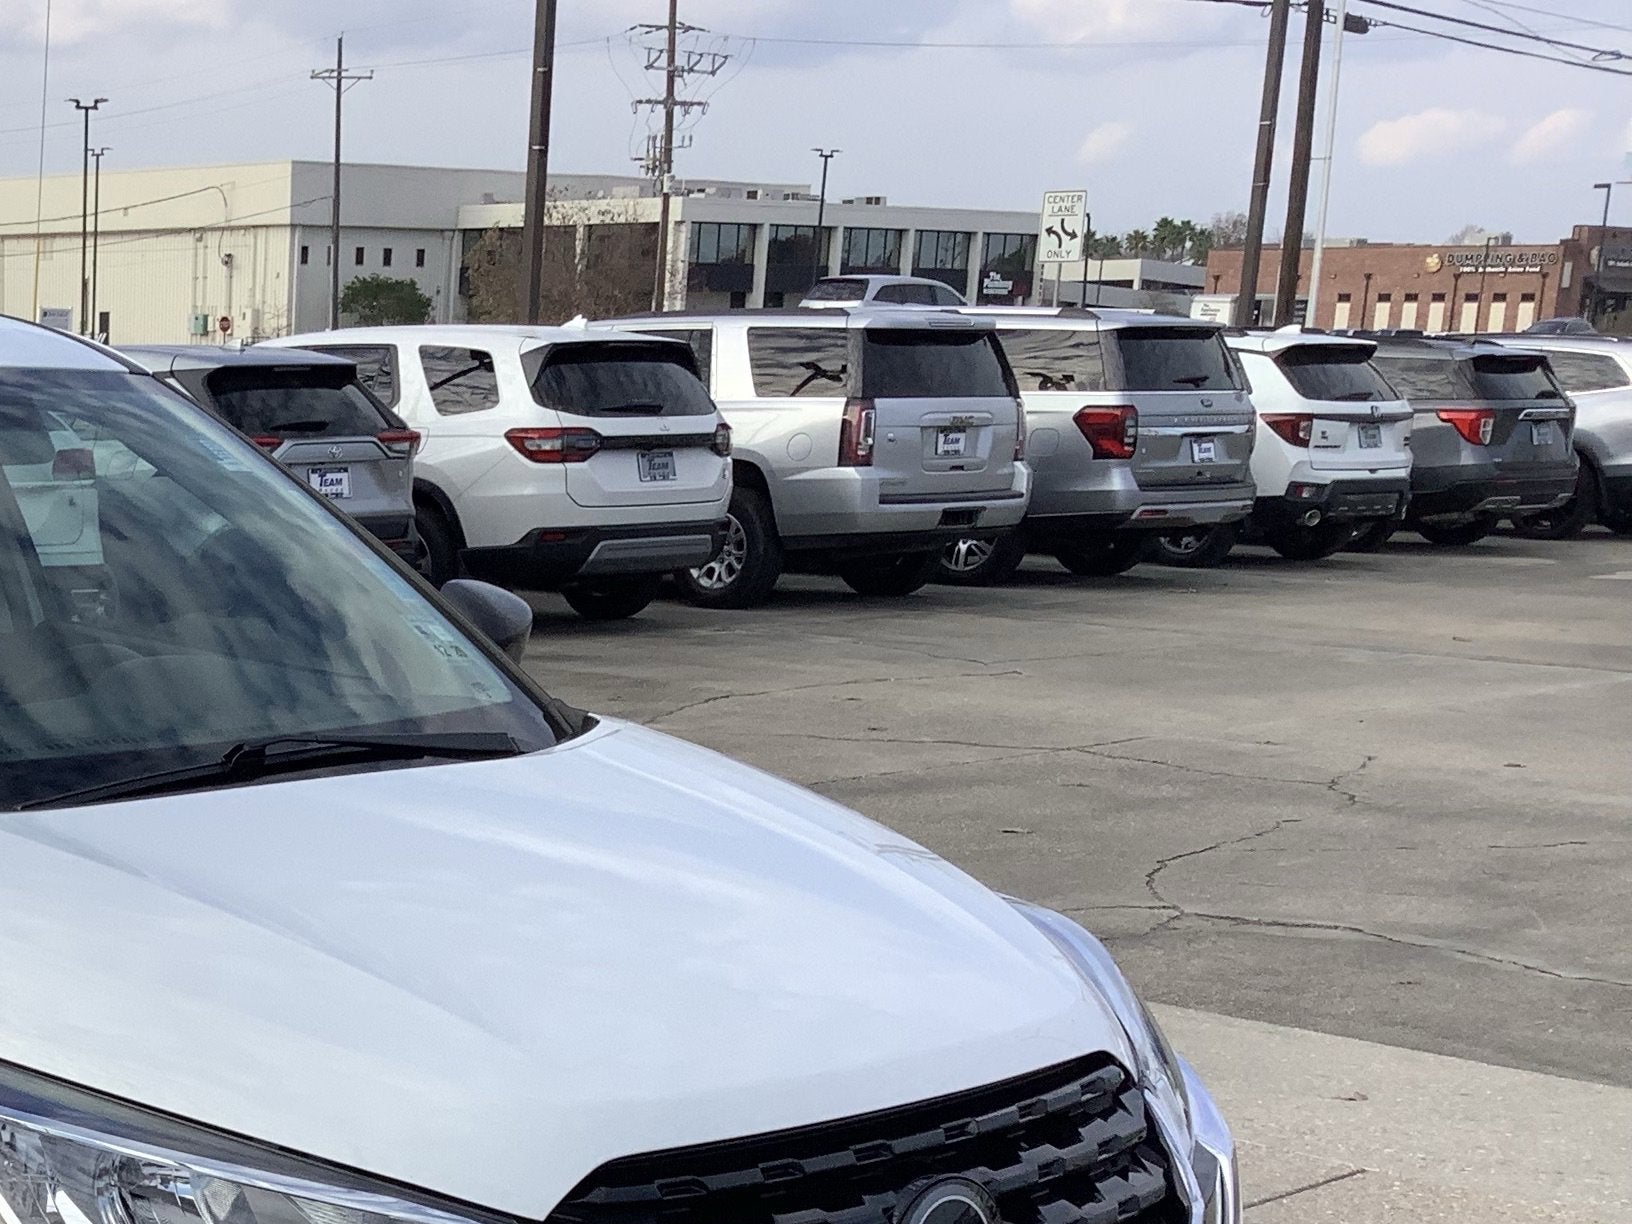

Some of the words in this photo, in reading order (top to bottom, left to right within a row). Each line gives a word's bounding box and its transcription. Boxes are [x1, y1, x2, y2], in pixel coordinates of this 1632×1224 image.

[1047, 194, 1083, 205] CENTER
[1051, 204, 1076, 214] LANE
[1047, 249, 1072, 259] ONLY
[1446, 252, 1513, 265] DUMPING
[318, 471, 343, 487] TEAM
